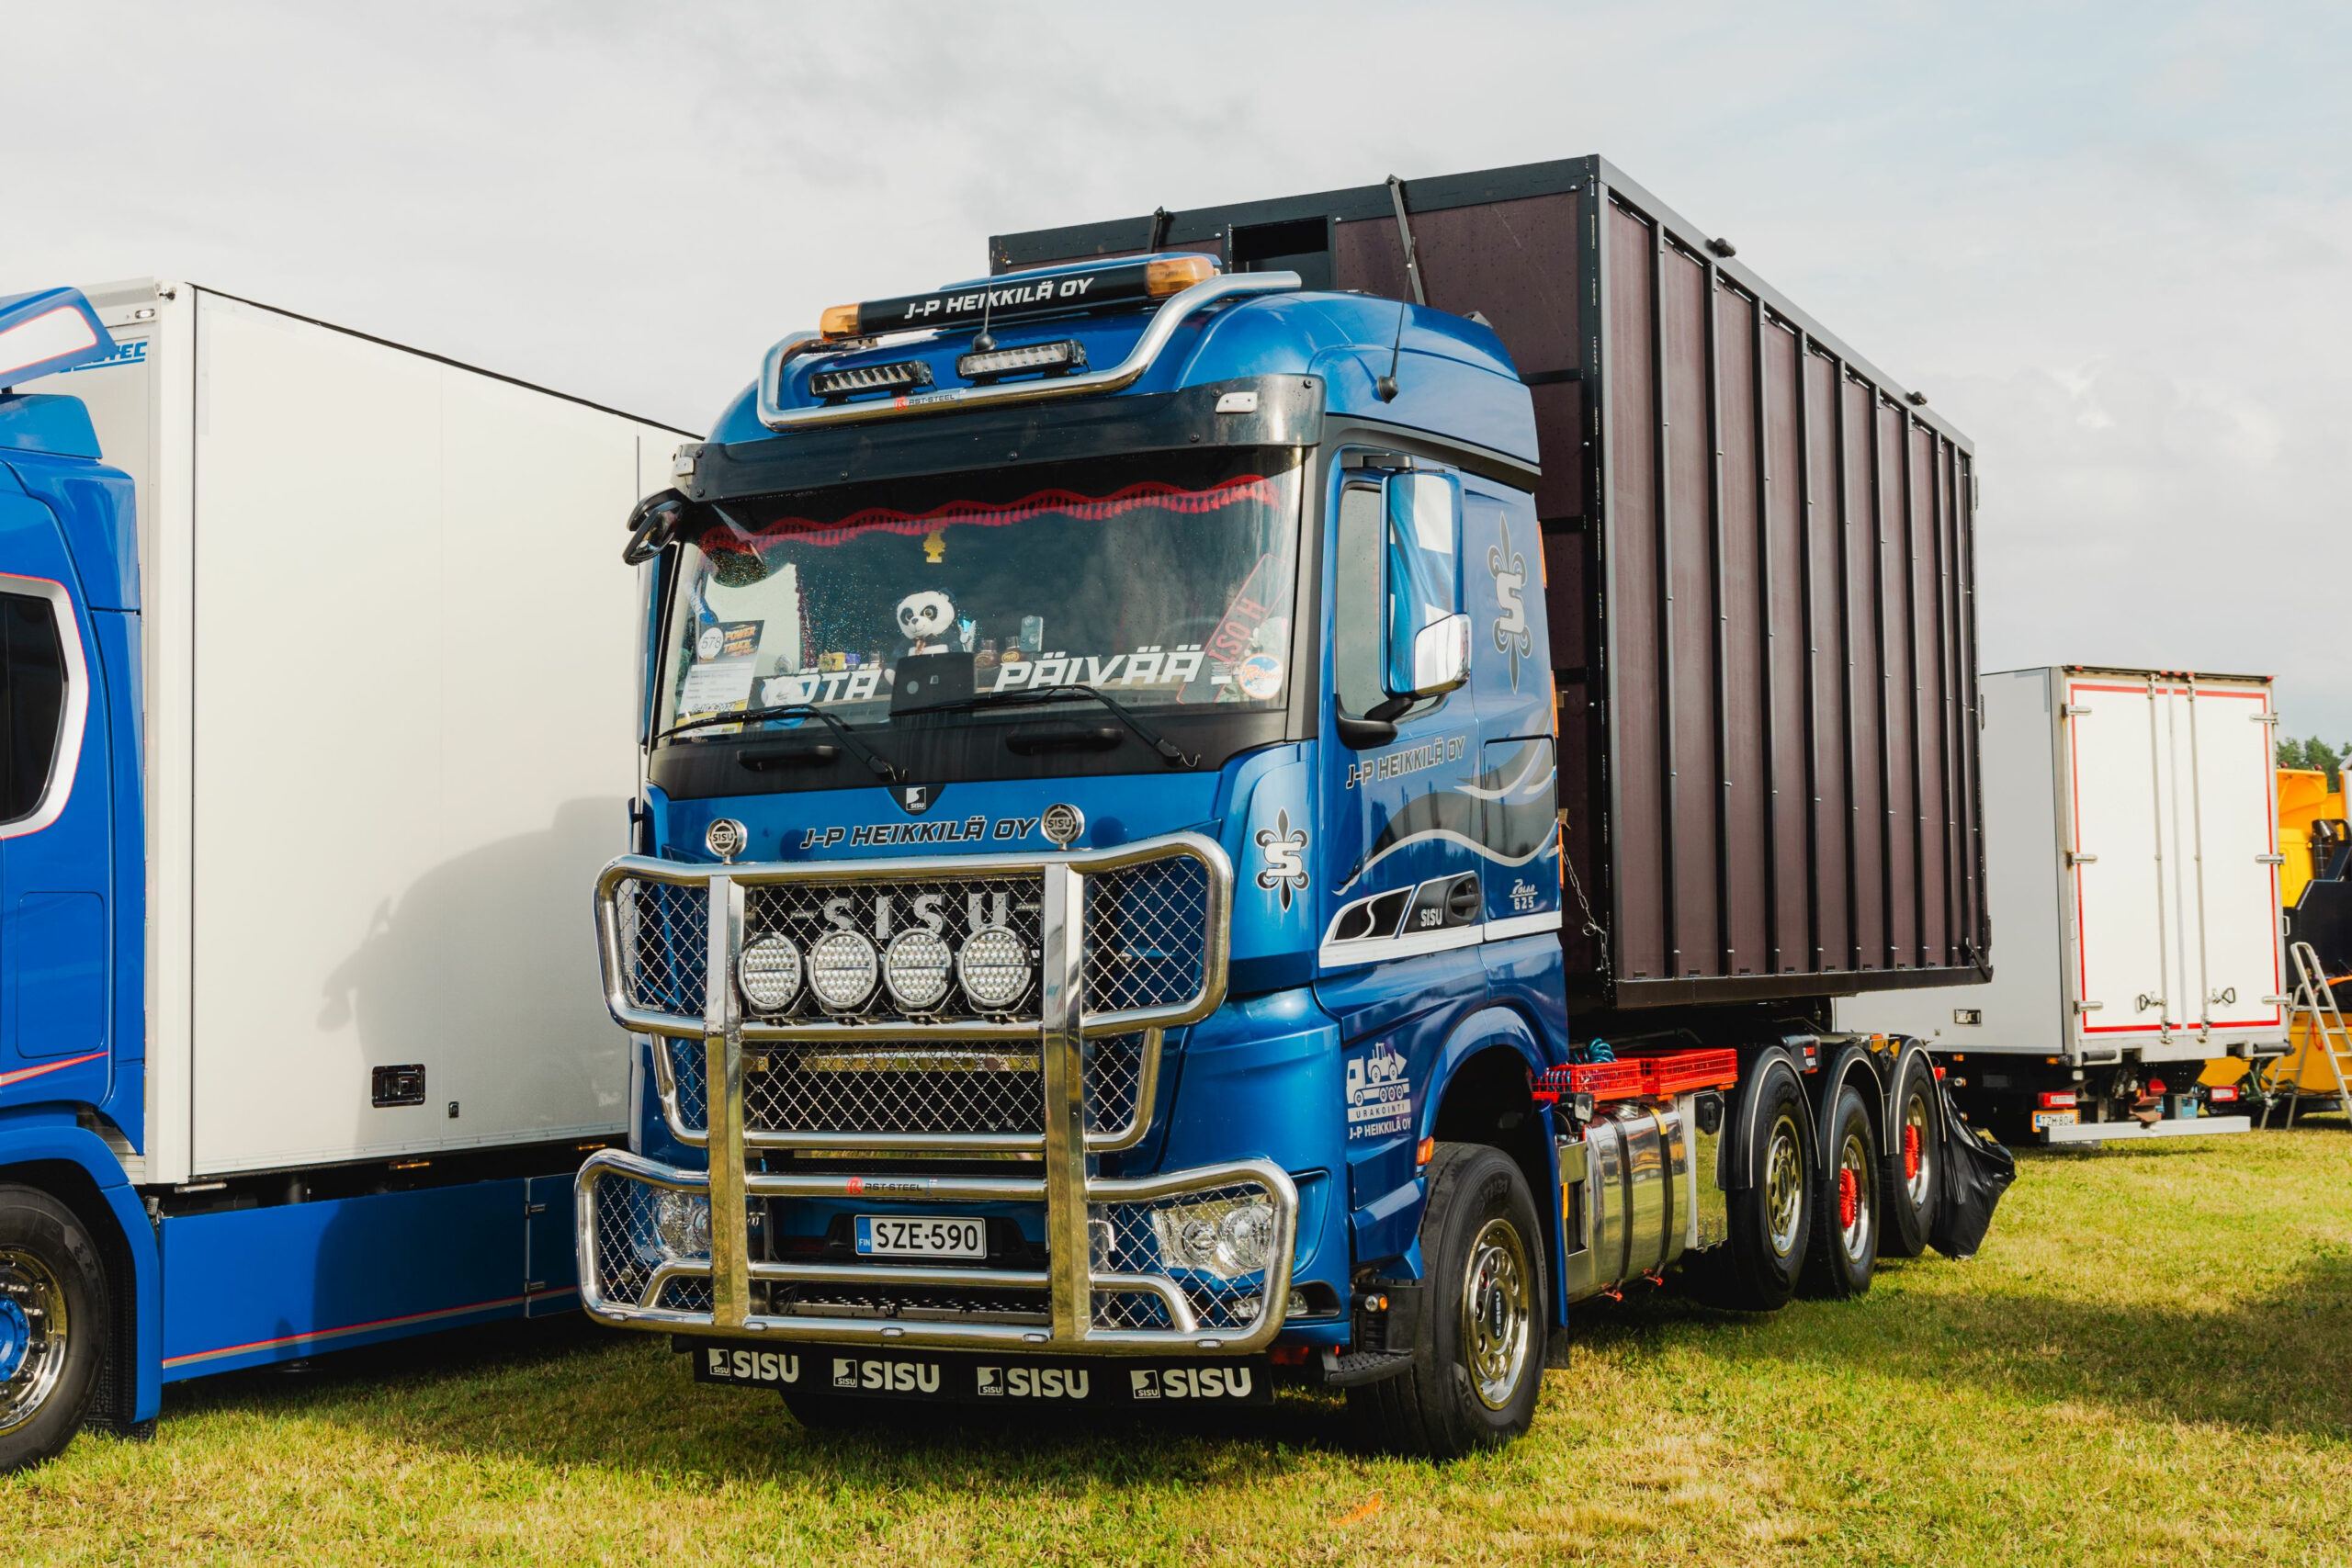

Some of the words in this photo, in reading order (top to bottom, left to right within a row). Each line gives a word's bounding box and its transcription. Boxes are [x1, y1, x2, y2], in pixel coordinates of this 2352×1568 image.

[904, 299, 941, 320] J-P
[945, 280, 1055, 314] HEIKKILÄ
[1059, 277, 1094, 299] OY
[701, 636, 722, 649] 578
[993, 644, 1205, 692] PÄIVÄÄ
[1346, 760, 1374, 790] J-P
[1377, 737, 1444, 781] HEIKKILÄ
[1447, 736, 1466, 761] OY
[800, 827, 845, 850] J-P
[851, 815, 988, 847] HEIKKILÄ
[992, 818, 1039, 840] OY
[1047, 818, 1072, 828] SISU
[713, 833, 734, 841] SISU
[1513, 897, 1534, 910] 625
[823, 892, 1009, 940] SISU
[1420, 908, 1443, 927] SISU
[1356, 1103, 1405, 1119] URAKOINTI
[1349, 1126, 1363, 1140] J-P
[1364, 1117, 1402, 1137] HEIKKILÄ
[1401, 1117, 1412, 1130] OY
[865, 1183, 922, 1191] RST-STEEL
[859, 1238, 870, 1247] FIN
[876, 1223, 978, 1251] SZE-590
[713, 1366, 729, 1375] SISU
[733, 1350, 799, 1382] SISU
[838, 1378, 855, 1386] SISU
[862, 1360, 940, 1393] SISU
[1007, 1368, 1090, 1399] SISU
[1162, 1367, 1252, 1398] SISU
[982, 1386, 1002, 1394] SISU
[1137, 1389, 1159, 1398] SISU
